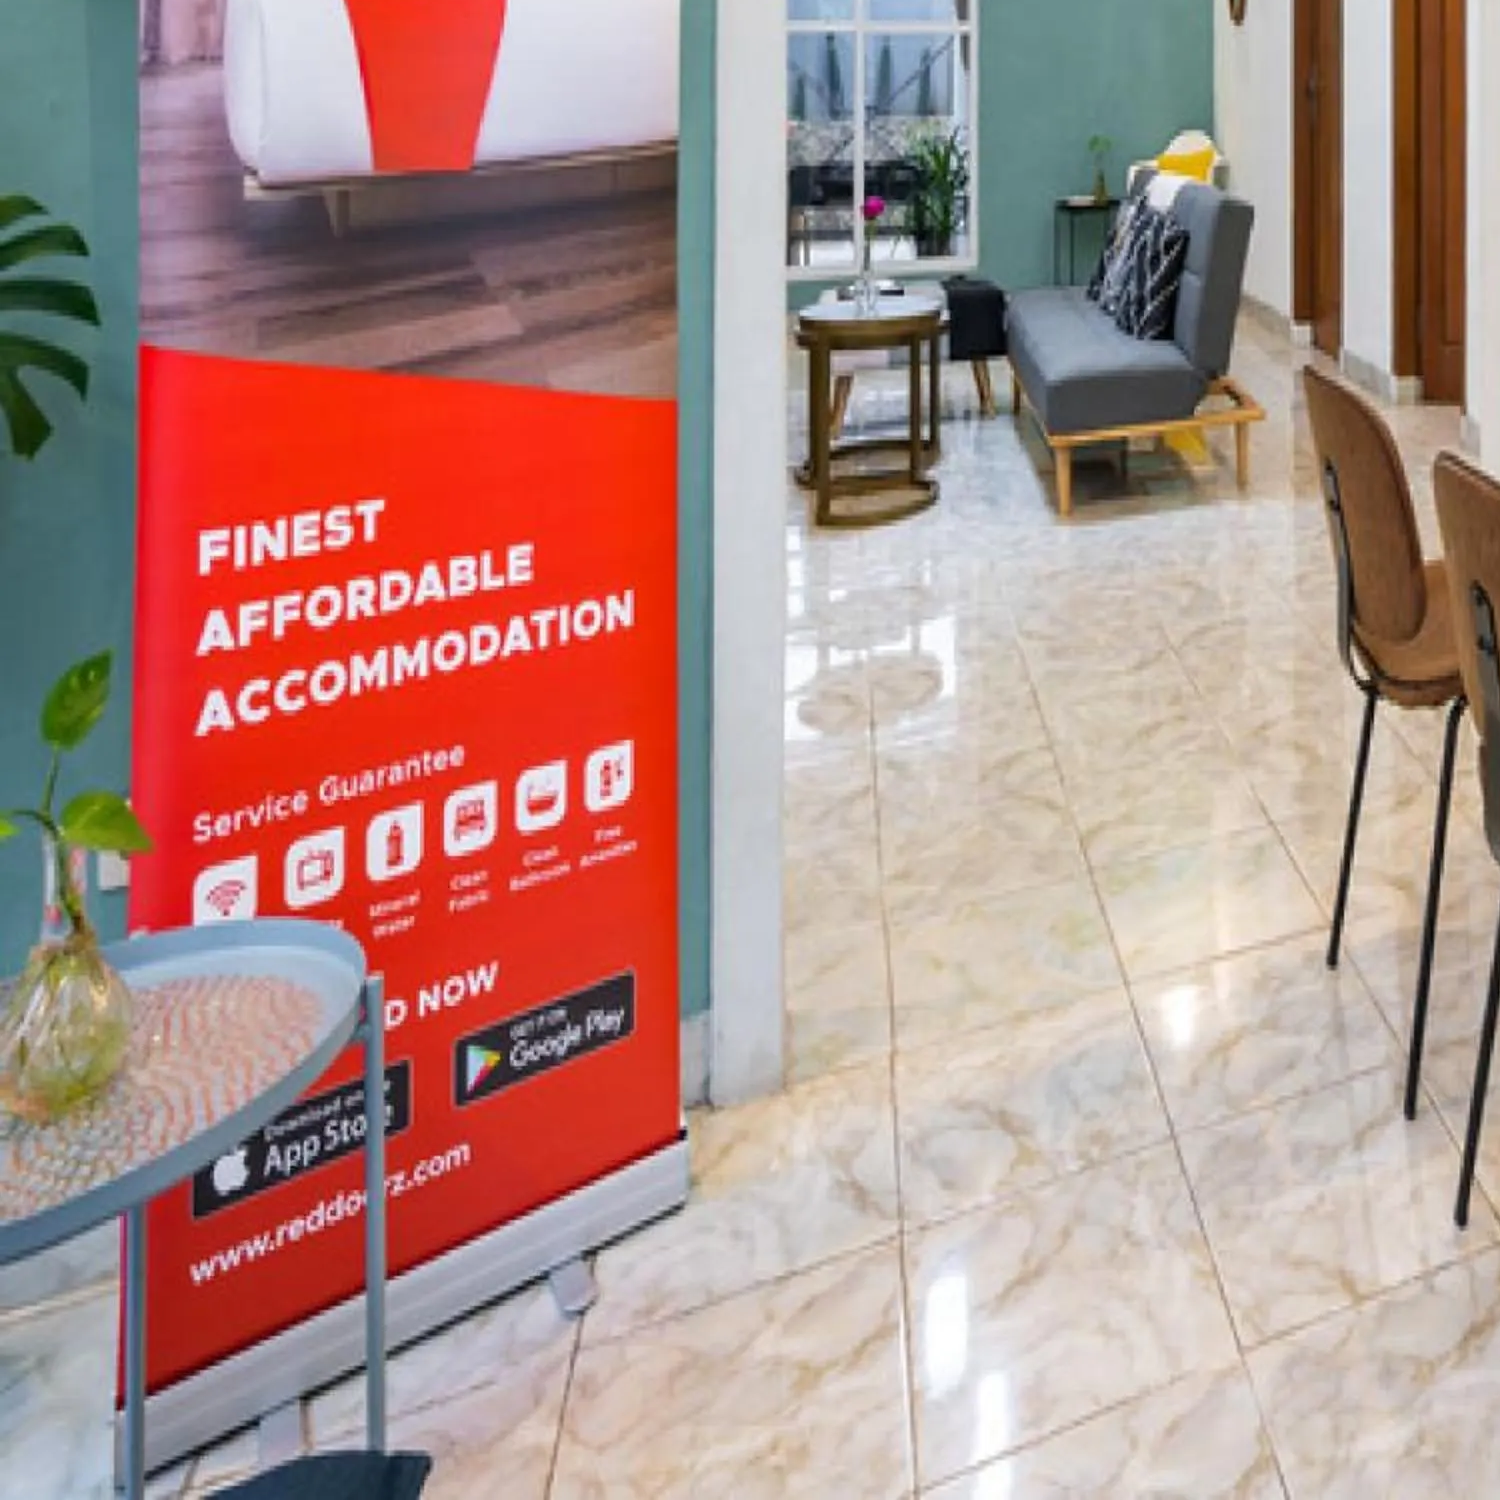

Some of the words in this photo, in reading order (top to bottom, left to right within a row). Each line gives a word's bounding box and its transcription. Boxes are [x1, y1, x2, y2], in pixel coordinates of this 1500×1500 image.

[198, 499, 386, 576] FINEST
[195, 543, 535, 657] AFFORDABLE
[194, 590, 635, 736] ACCOMMODATION
[193, 791, 308, 844] Service
[319, 745, 465, 806] Guarantee
[418, 961, 499, 1021] NOW
[509, 1022, 582, 1069] Google
[585, 1007, 626, 1039] Play
[263, 1134, 322, 1177] App
